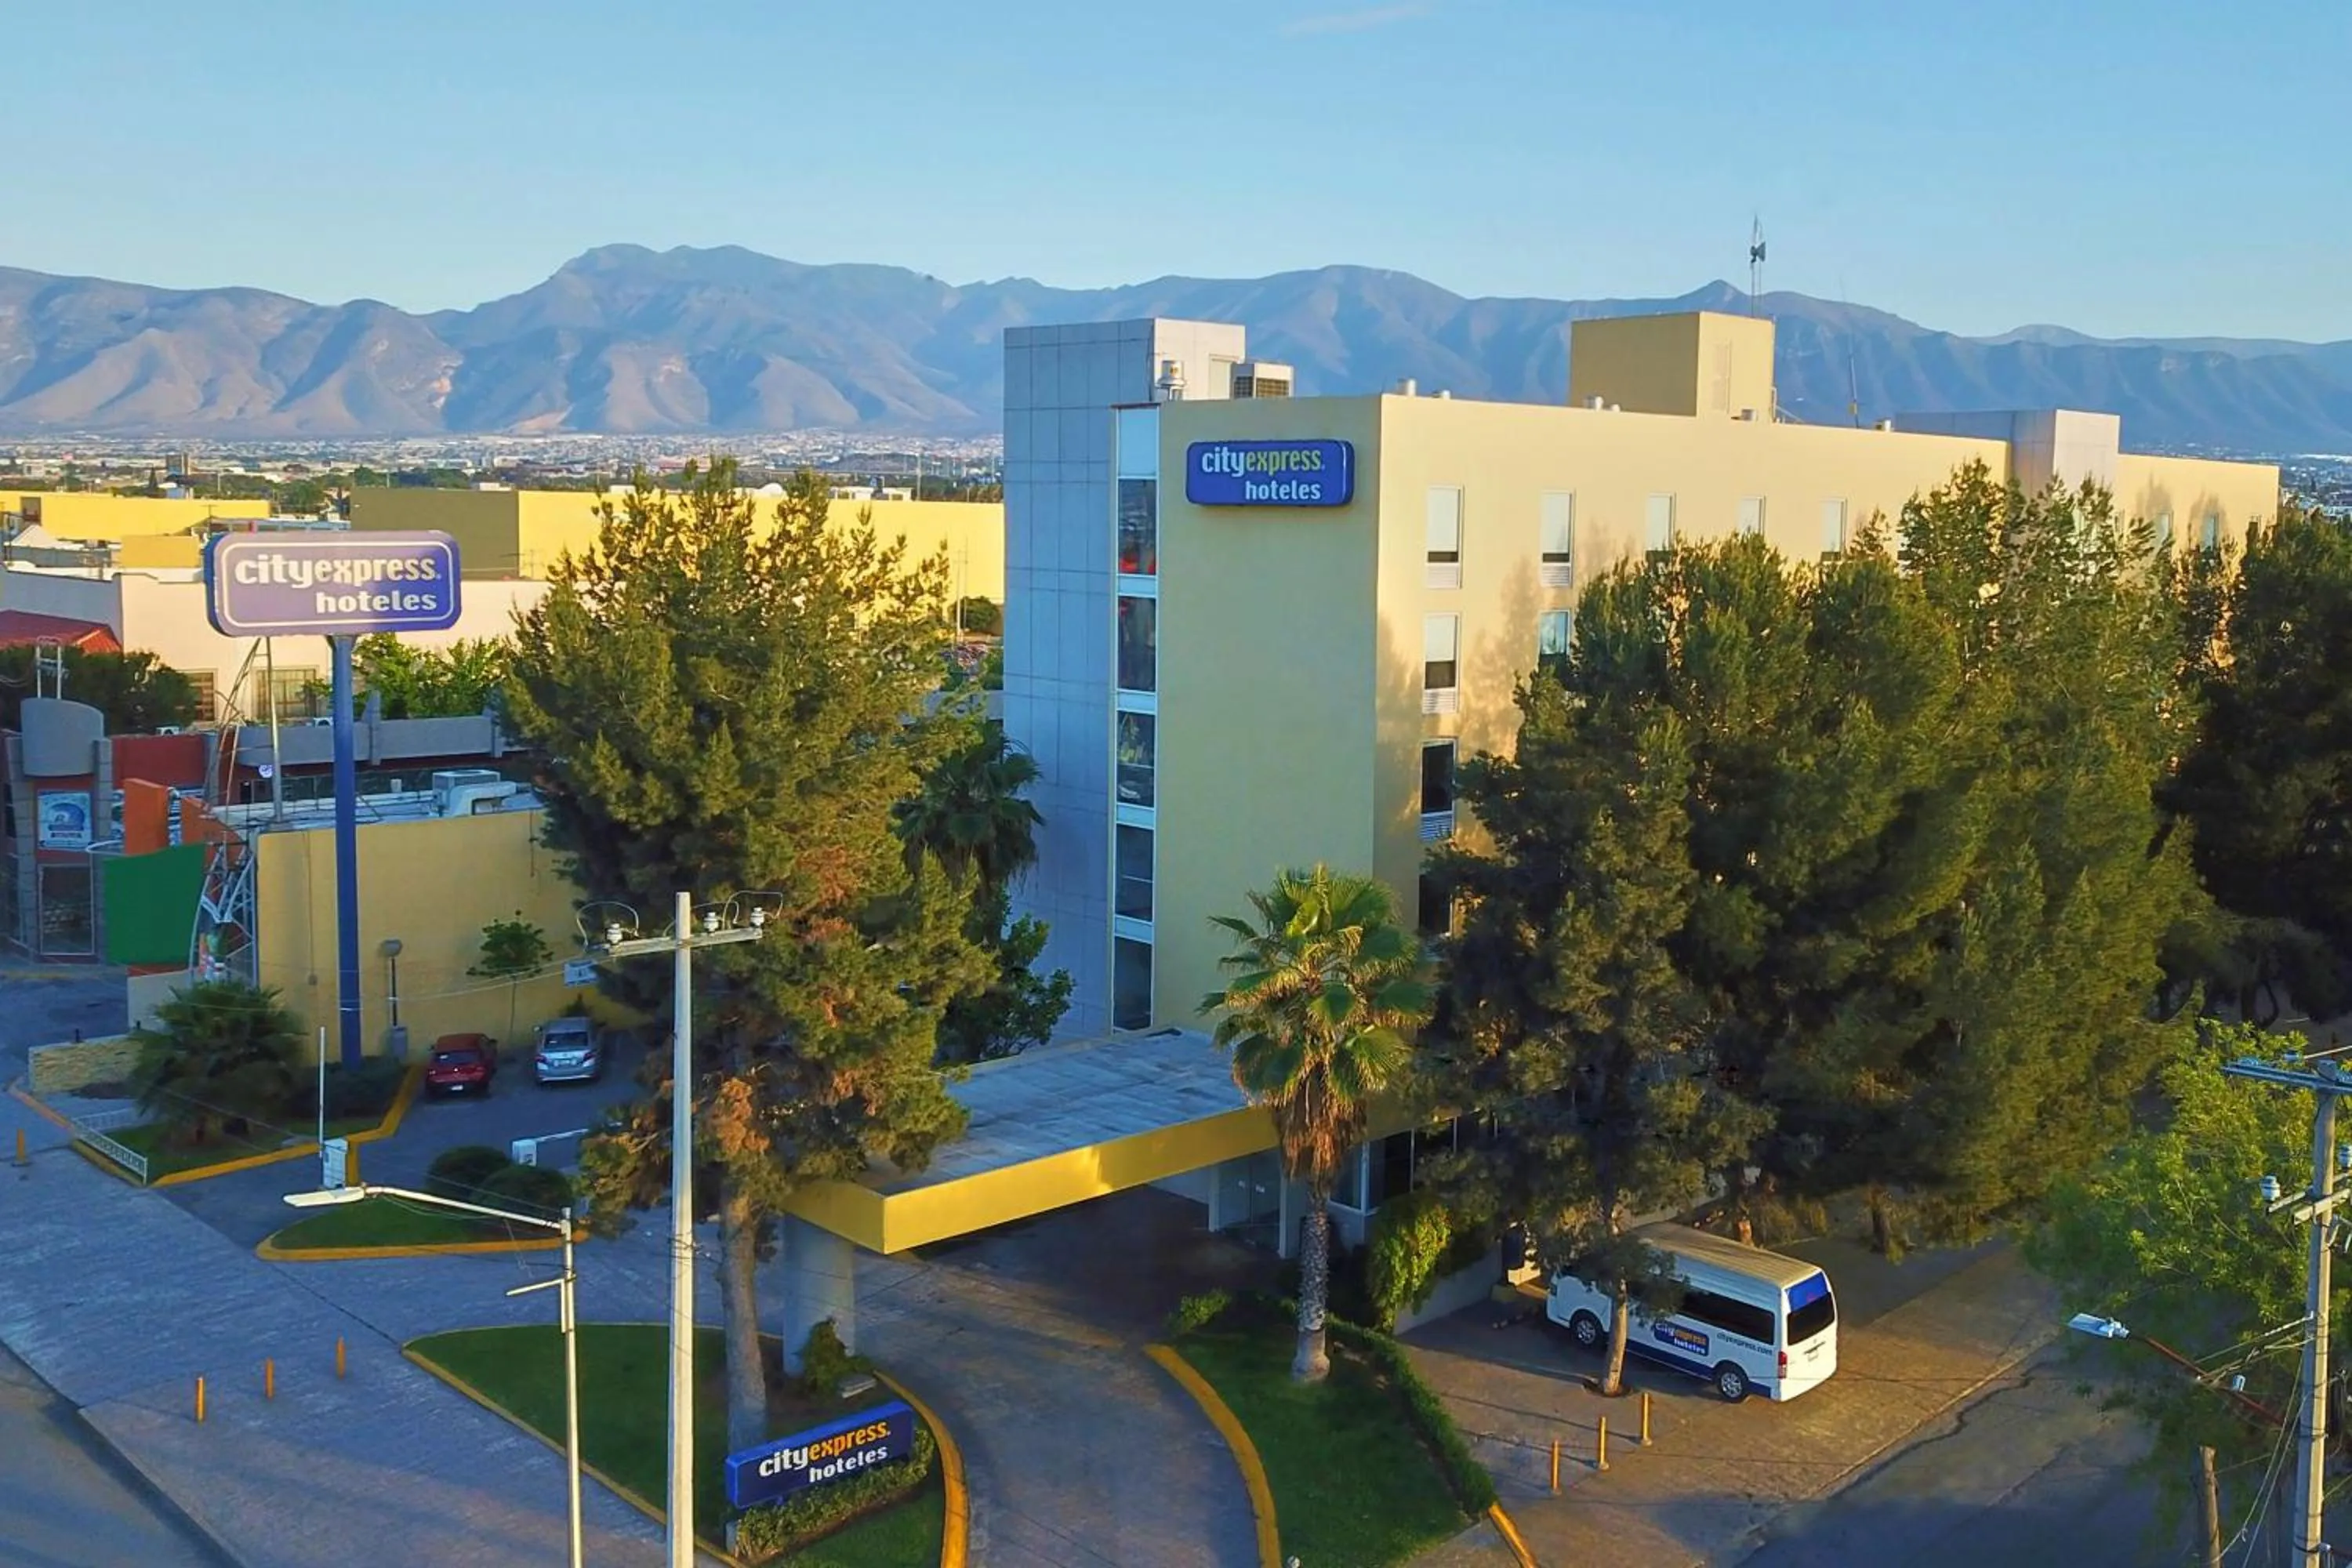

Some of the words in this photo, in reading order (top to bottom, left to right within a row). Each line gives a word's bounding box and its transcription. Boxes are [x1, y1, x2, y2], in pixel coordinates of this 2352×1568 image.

[1245, 480, 1321, 499] hoteles
[316, 590, 437, 613] hoteles
[808, 1445, 889, 1483] hoteles
